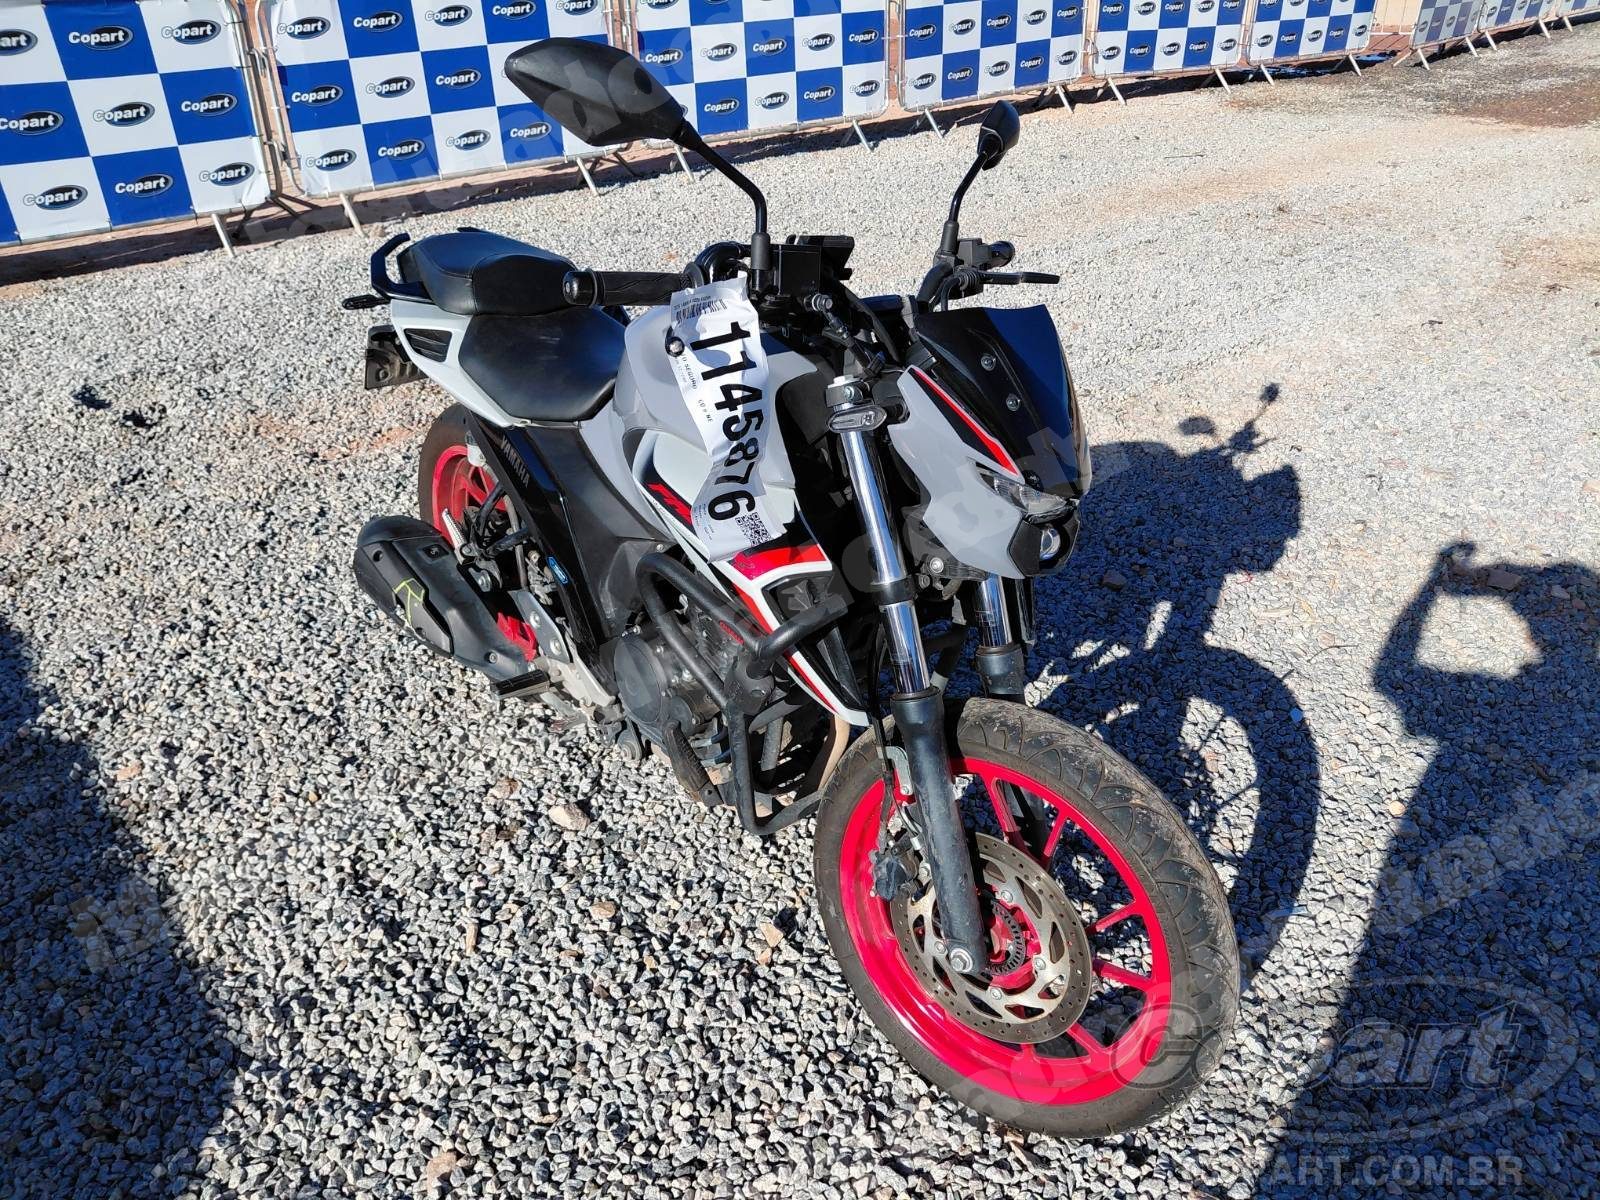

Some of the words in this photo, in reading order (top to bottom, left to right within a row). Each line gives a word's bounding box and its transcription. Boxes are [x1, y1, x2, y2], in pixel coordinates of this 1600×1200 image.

[492, 4, 530, 17] Copart
[556, 0, 592, 11] Copart
[1057, 8, 1077, 17] Copart
[1102, 5, 1122, 14] Copart
[353, 14, 396, 29] Copart
[425, 9, 466, 22] Copart
[986, 16, 1009, 28] Copart
[161, 23, 214, 41] Copart
[278, 21, 323, 35] Copart
[909, 27, 934, 38] Copart
[68, 28, 125, 45] Copart
[802, 36, 831, 48] Copart
[849, 31, 875, 43] Copart
[700, 46, 732, 59] Copart
[752, 41, 783, 53] Copart
[645, 51, 679, 64] Copart
[1020, 58, 1042, 69] Copart
[435, 71, 475, 86] Copart
[947, 69, 971, 81] Copart
[365, 79, 408, 95] Copart
[291, 87, 337, 103] Copart
[755, 94, 785, 107] Copart
[804, 88, 832, 101] Copart
[181, 97, 230, 114] Copart
[704, 100, 735, 113] Copart
[93, 106, 146, 122] Copart
[0, 115, 54, 131] Copart
[510, 125, 547, 139] Copart
[446, 134, 485, 148] Copart
[378, 142, 419, 158] Copart
[305, 152, 350, 168] Copart
[199, 166, 247, 184] Copart
[115, 177, 166, 195] Copart
[23, 189, 79, 207] Copart
[689, 321, 765, 521] 1145876
[500, 435, 530, 489] YAMAHA
